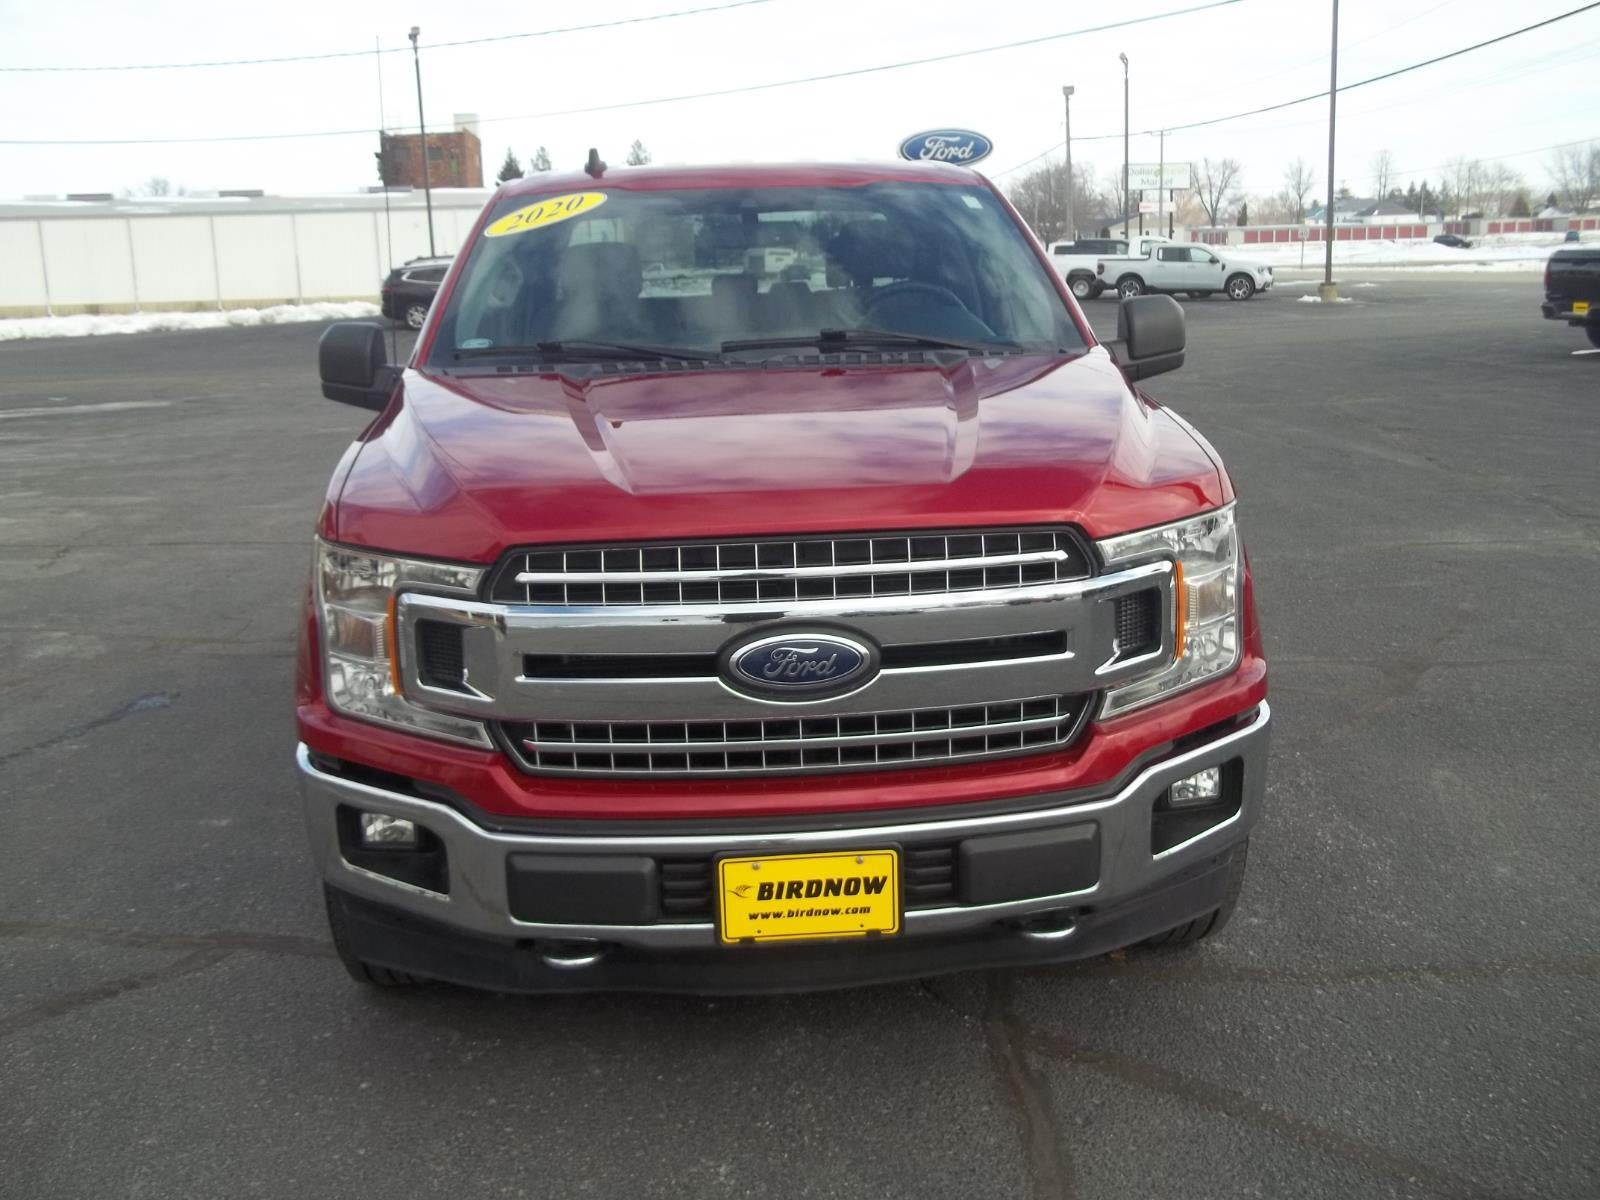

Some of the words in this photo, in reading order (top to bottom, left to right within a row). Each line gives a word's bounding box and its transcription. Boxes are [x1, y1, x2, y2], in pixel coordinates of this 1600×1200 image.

[919, 136, 975, 160] Ford
[505, 195, 585, 231] 2020
[763, 647, 837, 678] Ford
[757, 875, 888, 901] BIRDNOW
[748, 905, 871, 920] www.birdnow.com
